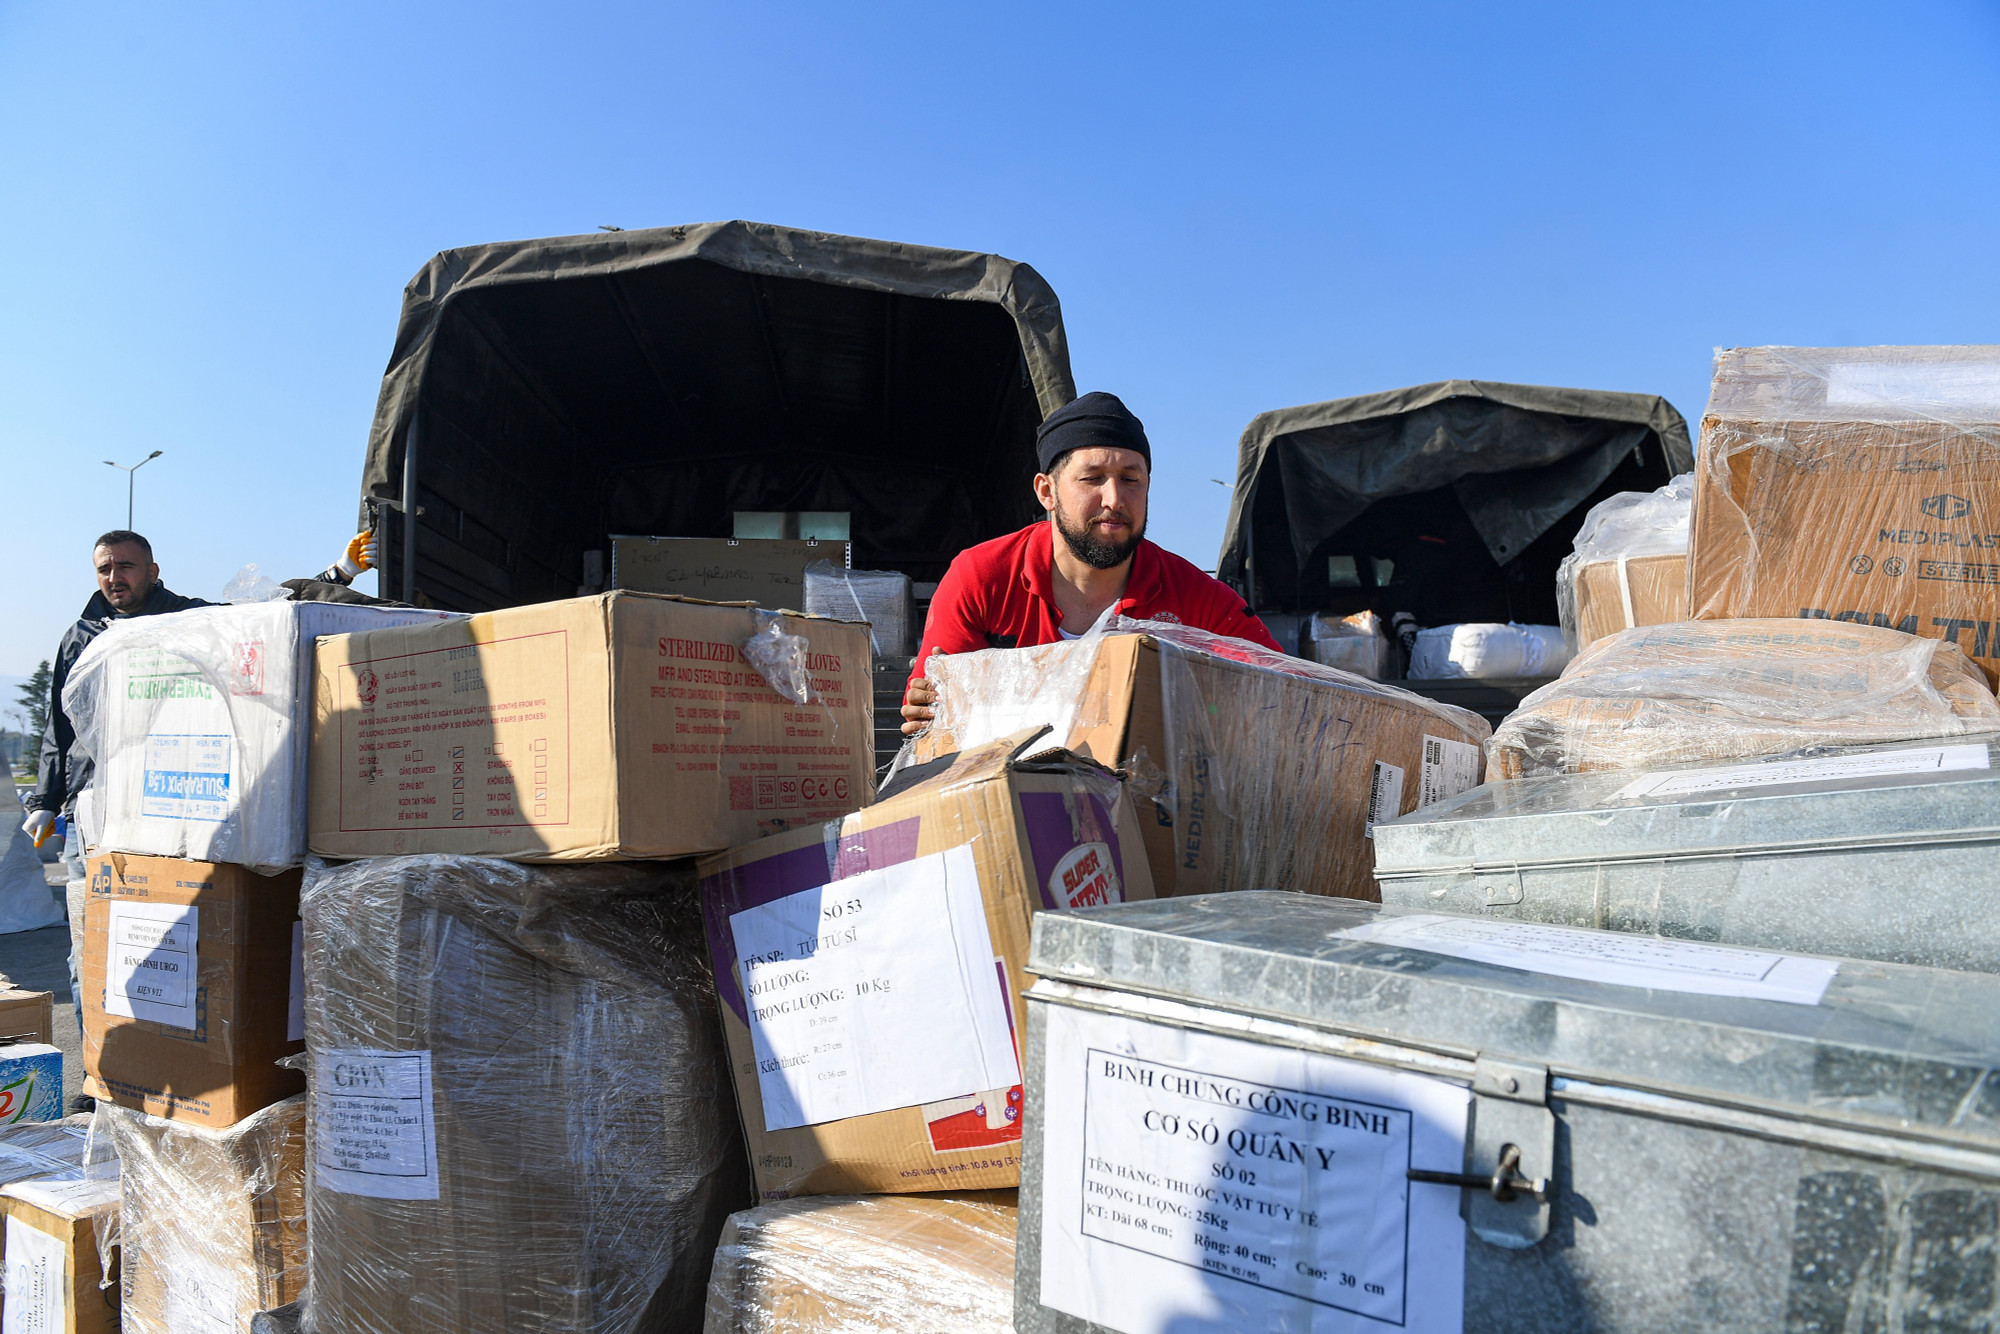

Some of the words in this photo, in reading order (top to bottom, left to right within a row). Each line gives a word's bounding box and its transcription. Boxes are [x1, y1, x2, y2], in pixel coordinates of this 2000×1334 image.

[1925, 564, 1998, 580] STERILE
[658, 637, 734, 663] STERILIZED
[658, 665, 675, 681] MFR
[678, 667, 693, 682] AND
[694, 668, 732, 686] STERILIZED
[734, 672, 743, 687] AT
[497, 702, 518, 710] MONTHS
[518, 700, 533, 708] FROM
[534, 698, 546, 706] MFG
[500, 716, 517, 724] PAIRS
[524, 712, 546, 721] BOXES)
[780, 782, 796, 793] ISO
[1062, 849, 1100, 895] SUPER
[94, 875, 110, 892] AP
[823, 900, 843, 921] SỐ
[847, 899, 863, 915] 53
[744, 954, 766, 973] TÊN
[767, 950, 785, 965] SP:
[797, 936, 820, 956] TÚI
[844, 926, 857, 944] SĨ
[124, 956, 142, 968] BĂNG
[142, 958, 158, 970] DÍNH
[160, 962, 179, 972] URGO
[136, 985, 151, 996] KIỆN
[748, 980, 762, 998] SỐ
[764, 969, 810, 993] LƯỢNG:
[752, 1001, 790, 1023] TRỌNG
[792, 988, 845, 1012] LƯỢNG:
[855, 981, 869, 996] 10
[872, 977, 891, 993] Kg
[814, 1046, 822, 1054] R:
[823, 1044, 831, 1052] 27
[832, 1042, 843, 1050] cm
[760, 1057, 780, 1074] Kích
[781, 1052, 810, 1069] thước:
[827, 1071, 836, 1079] 36
[1104, 1061, 1154, 1087] BINH
[1248, 1090, 1319, 1122] CÔNG
[1325, 1106, 1390, 1136] BINH
[1143, 1109, 1181, 1136] CƠ
[1227, 1129, 1309, 1166] QUÂN
[1315, 1146, 1336, 1172] Y
[900, 1168, 921, 1178] Khối
[922, 1166, 948, 1176] lượng
[970, 1160, 989, 1170] 10,8
[990, 1158, 1003, 1168] kg
[1004, 1156, 1014, 1167] (3
[1211, 1161, 1235, 1182] SỐ
[1239, 1170, 1257, 1187] 02
[1087, 1156, 1113, 1174] TÊN
[1117, 1163, 1161, 1187] HÀNG:
[1164, 1177, 1219, 1204] THUỐC,
[1222, 1191, 1253, 1211] VẬT
[1256, 1200, 1280, 1217] TƯ
[1283, 1206, 1295, 1222] Y
[1087, 1180, 1134, 1203] TRỌNG
[1137, 1194, 1192, 1220] LƯỢNG:
[1195, 1210, 1229, 1232] 25Kg
[1086, 1203, 1109, 1220] KT:
[1111, 1209, 1132, 1226] Dài
[1134, 1215, 1149, 1230] 68
[1151, 1223, 1174, 1239] cm;
[1193, 1233, 1231, 1257] Rộng:
[1233, 1245, 1250, 1259] 40
[1252, 1250, 1278, 1270] cm;
[1295, 1261, 1329, 1282] Cao:
[1339, 1272, 1357, 1289] 30
[1363, 1281, 1386, 1297] cm
[1231, 1266, 1242, 1277] 02
